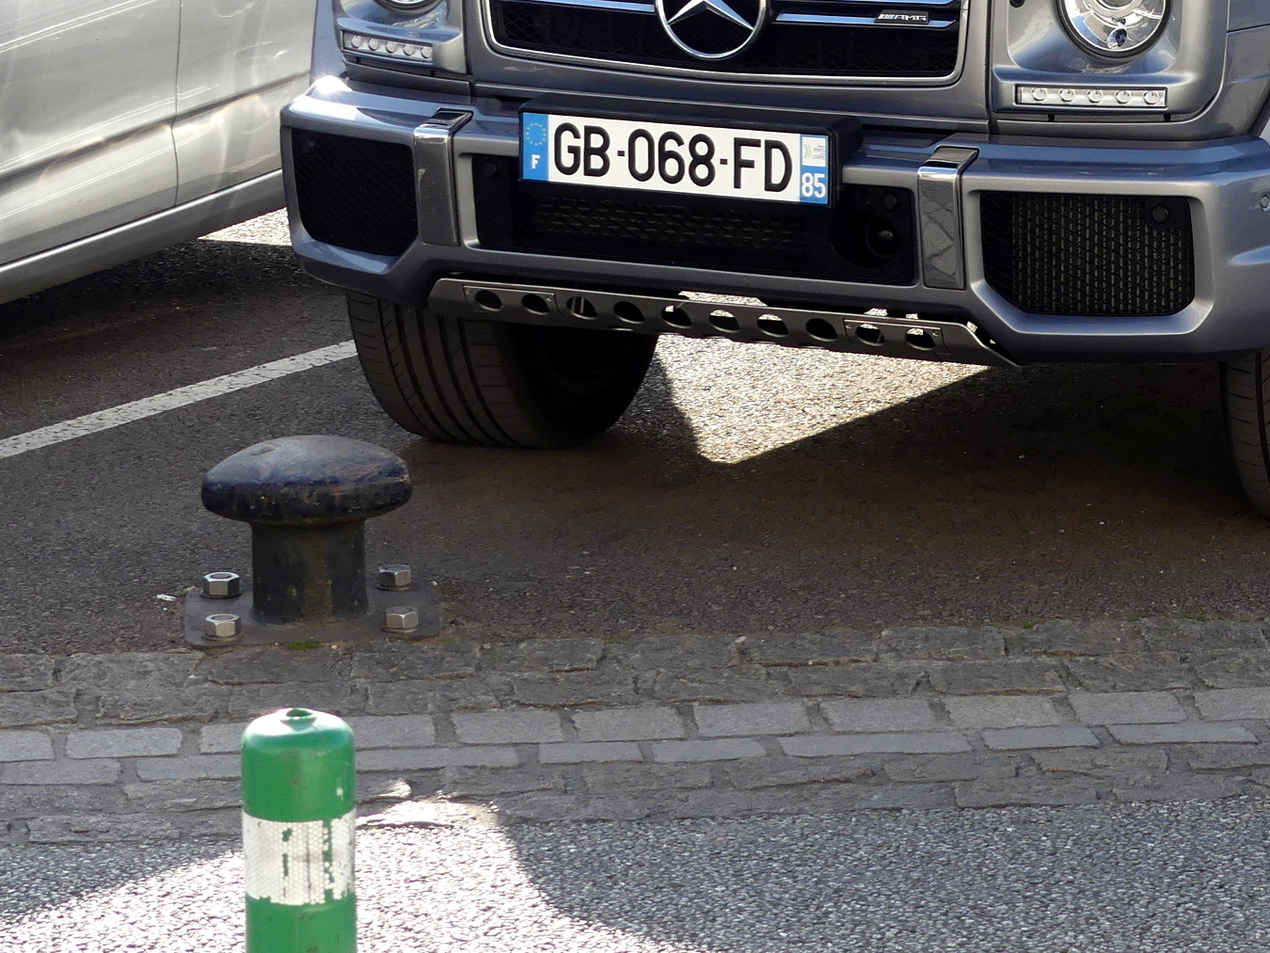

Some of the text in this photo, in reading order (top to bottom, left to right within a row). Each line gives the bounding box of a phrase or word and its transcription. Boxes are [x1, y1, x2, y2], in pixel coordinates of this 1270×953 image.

[530, 154, 541, 170] F
[554, 122, 793, 193] GB-068-FD
[801, 172, 826, 198] 85
